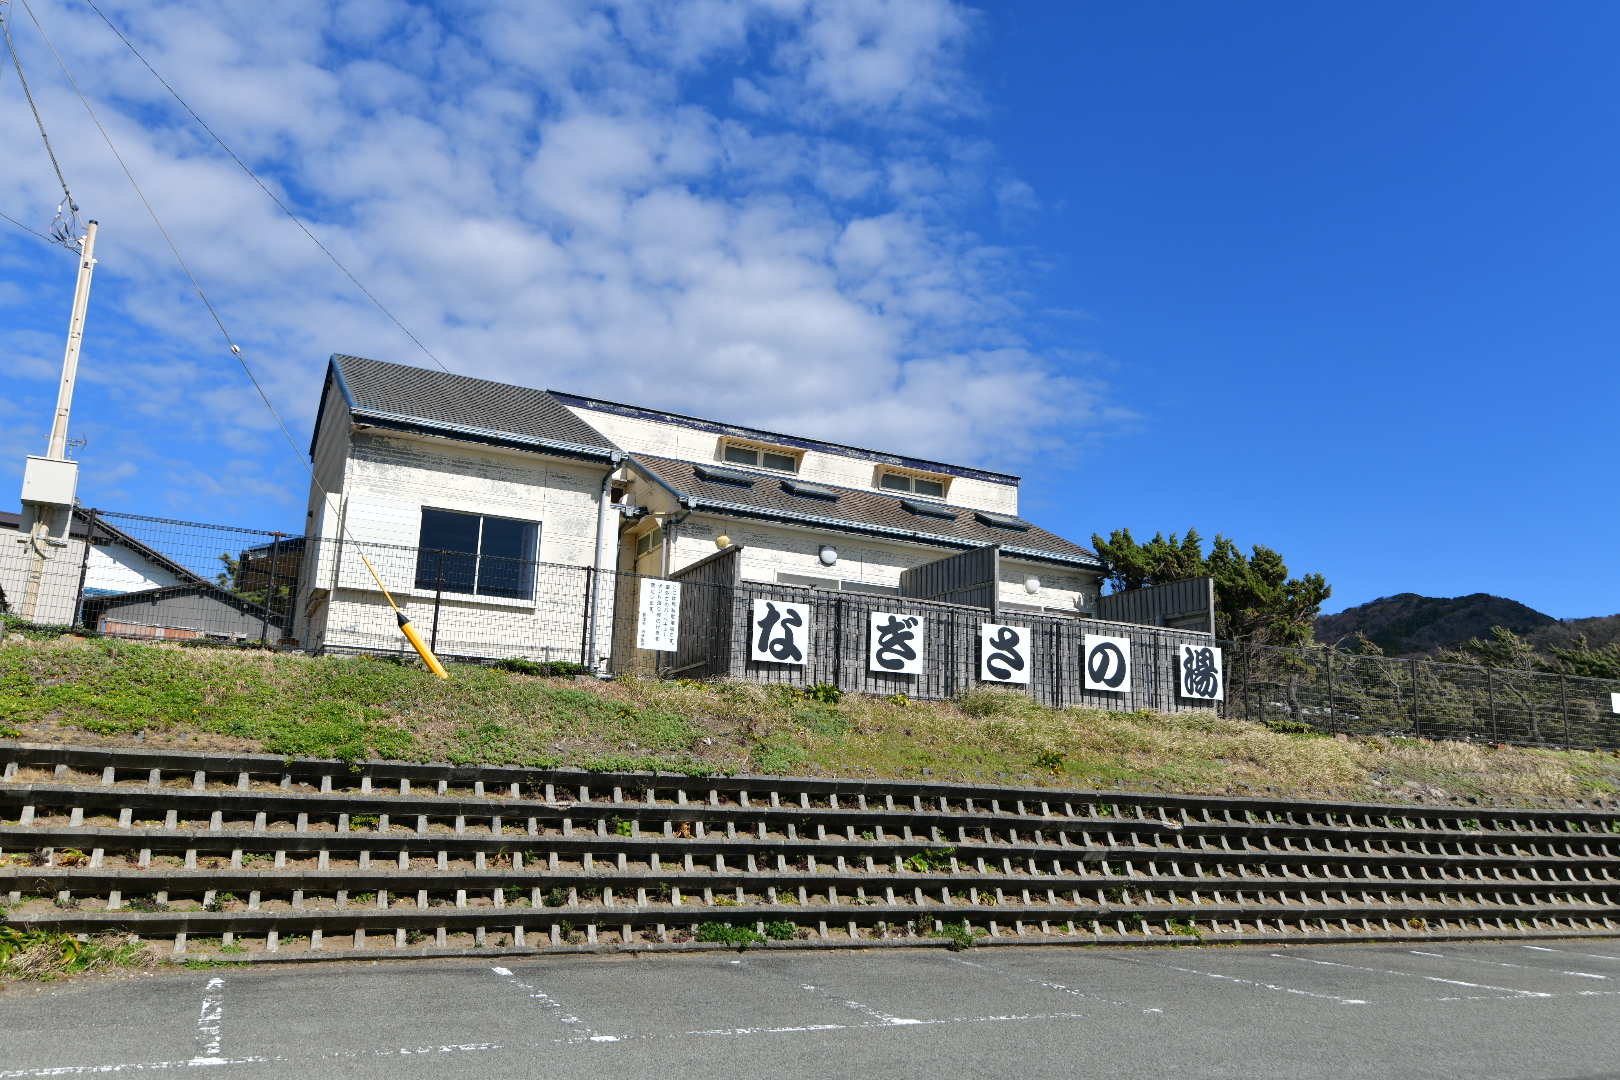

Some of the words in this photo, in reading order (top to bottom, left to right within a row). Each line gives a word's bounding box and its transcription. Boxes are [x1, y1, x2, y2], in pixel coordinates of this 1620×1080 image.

[757, 602, 1218, 699] なぎさの湯
